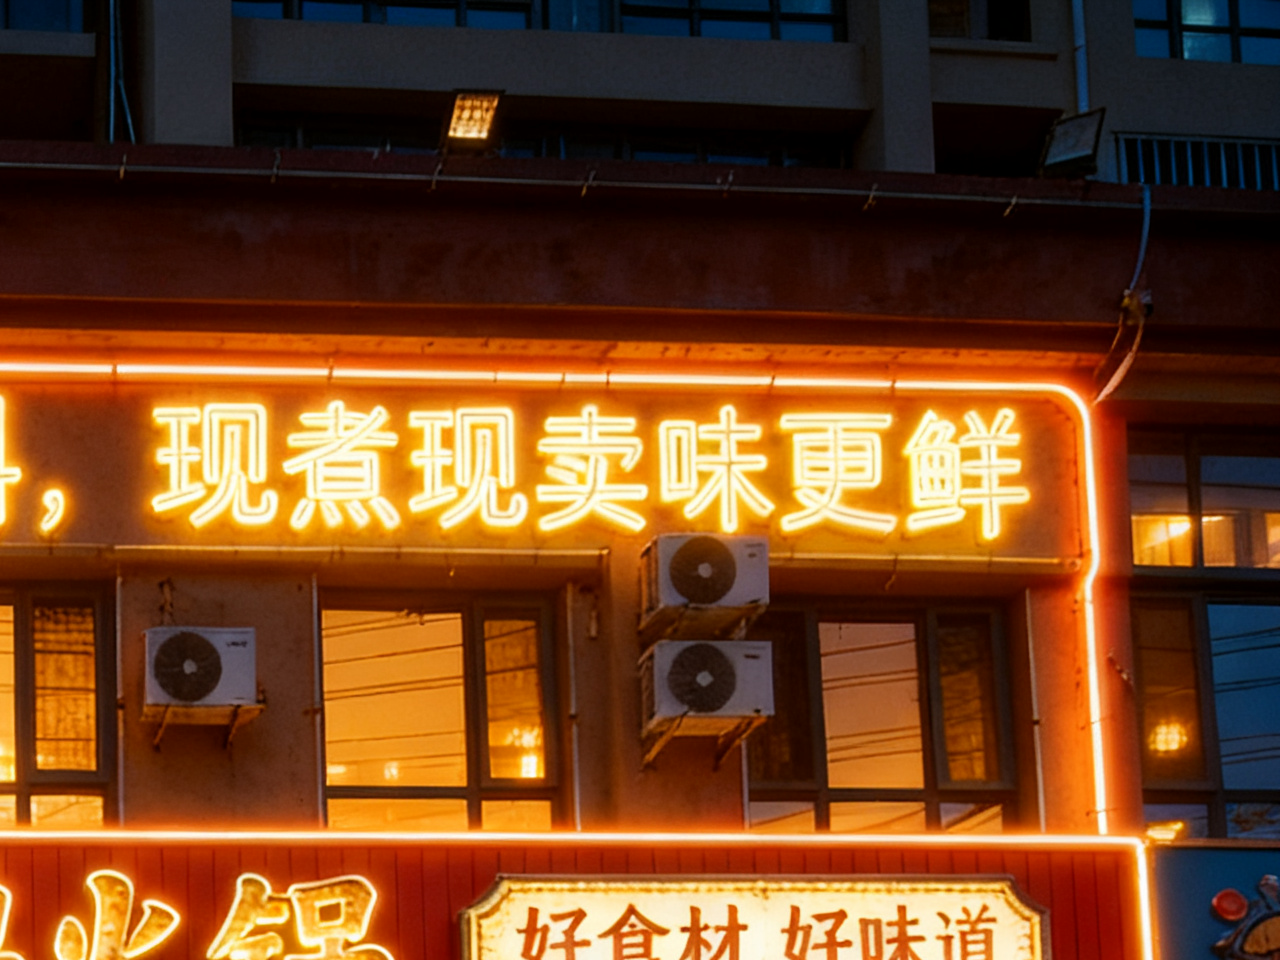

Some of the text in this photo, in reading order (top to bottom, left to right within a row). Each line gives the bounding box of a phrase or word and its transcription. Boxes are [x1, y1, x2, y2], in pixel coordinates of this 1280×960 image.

[150, 400, 1034, 540] 现煮现卖味更鲜
